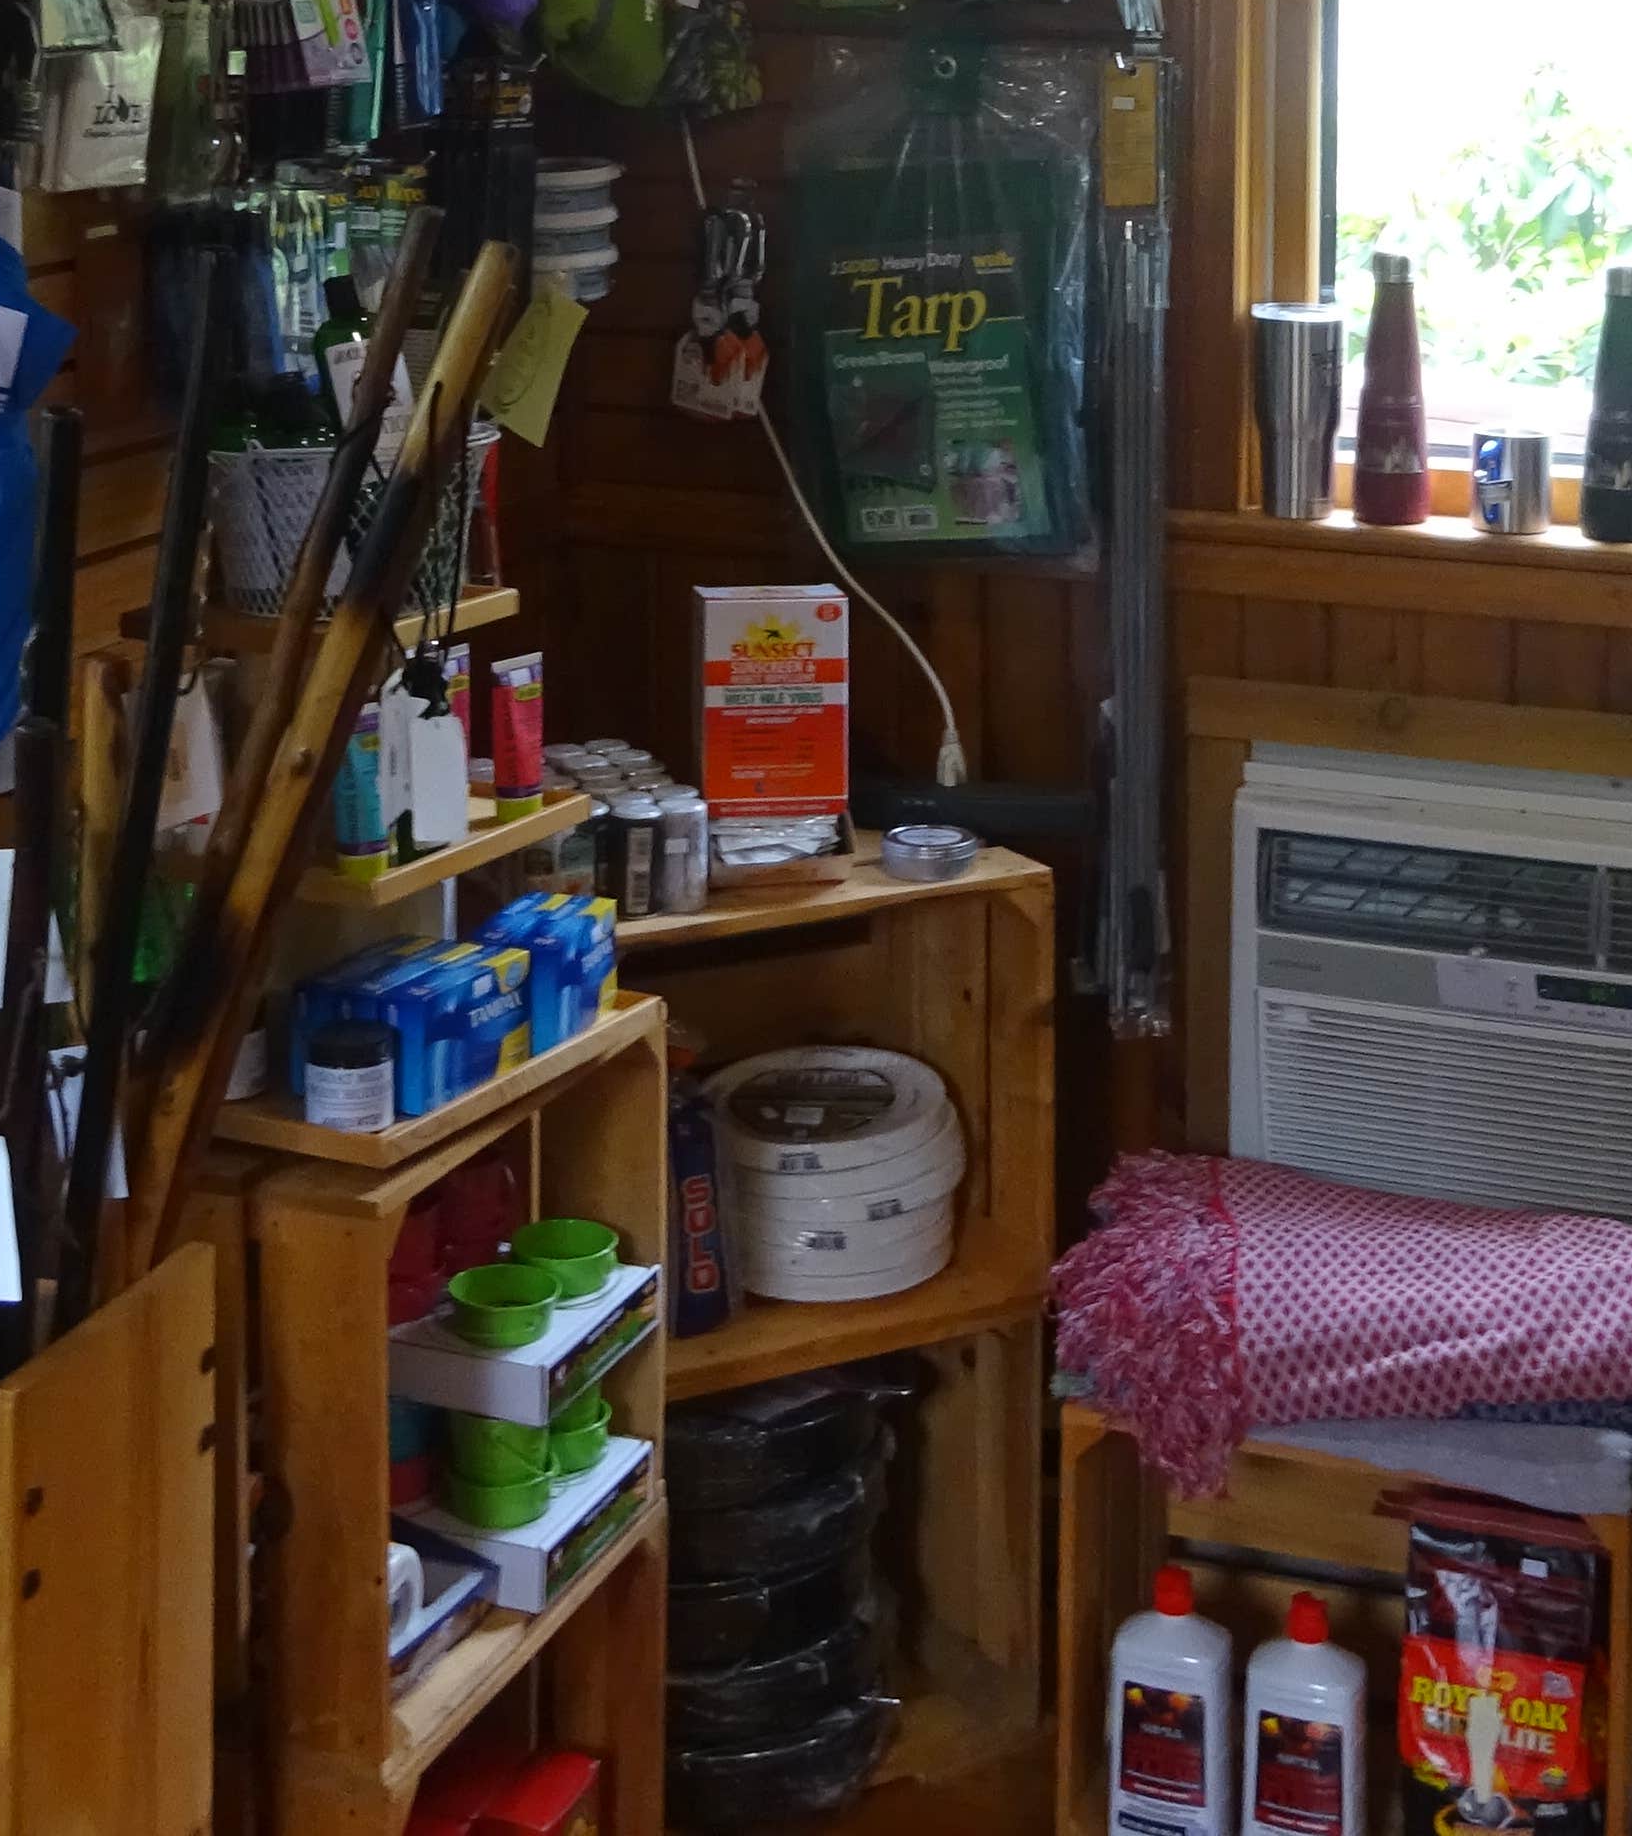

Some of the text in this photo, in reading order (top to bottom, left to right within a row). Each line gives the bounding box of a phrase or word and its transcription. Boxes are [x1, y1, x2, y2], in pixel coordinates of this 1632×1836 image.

[850, 275, 989, 353] Tarp
[730, 641, 817, 659] SUNSECT
[1411, 1675, 1504, 1714] ROY
[1508, 1696, 1569, 1733] OAK
